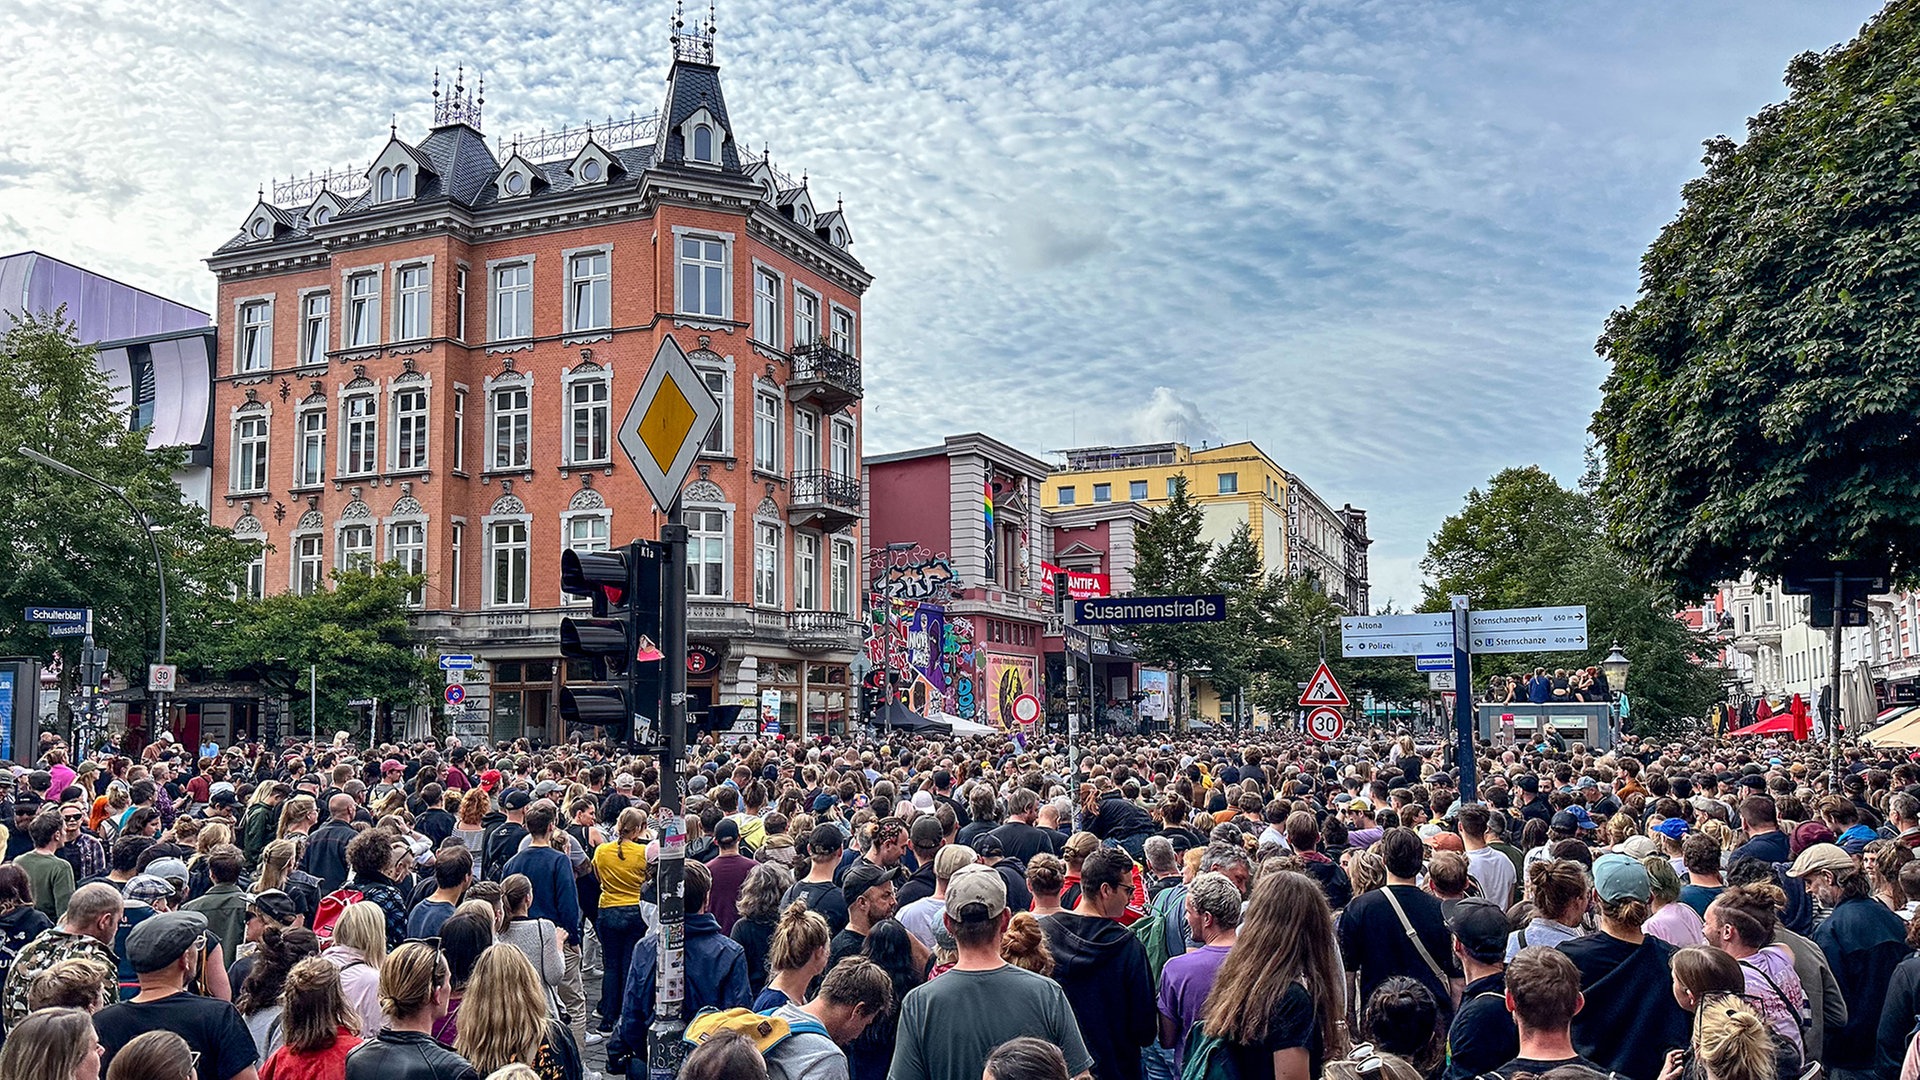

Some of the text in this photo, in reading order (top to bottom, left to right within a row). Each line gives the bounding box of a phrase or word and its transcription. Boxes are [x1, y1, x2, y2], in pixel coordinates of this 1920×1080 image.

[640, 546, 654, 559] K1a
[1068, 576, 1100, 590] ANTIFA
[32, 609, 82, 620] Schulterblatt
[1083, 599, 1216, 620] Susannenstraße
[1473, 612, 1543, 626] Sternschanzenpark
[50, 624, 85, 636] Juliusstraße
[1357, 621, 1383, 630] Altona
[1368, 641, 1394, 650] Polizei
[1495, 635, 1547, 647] Sternschanze
[157, 671, 169, 680] 30
[1315, 715, 1336, 732] 30
